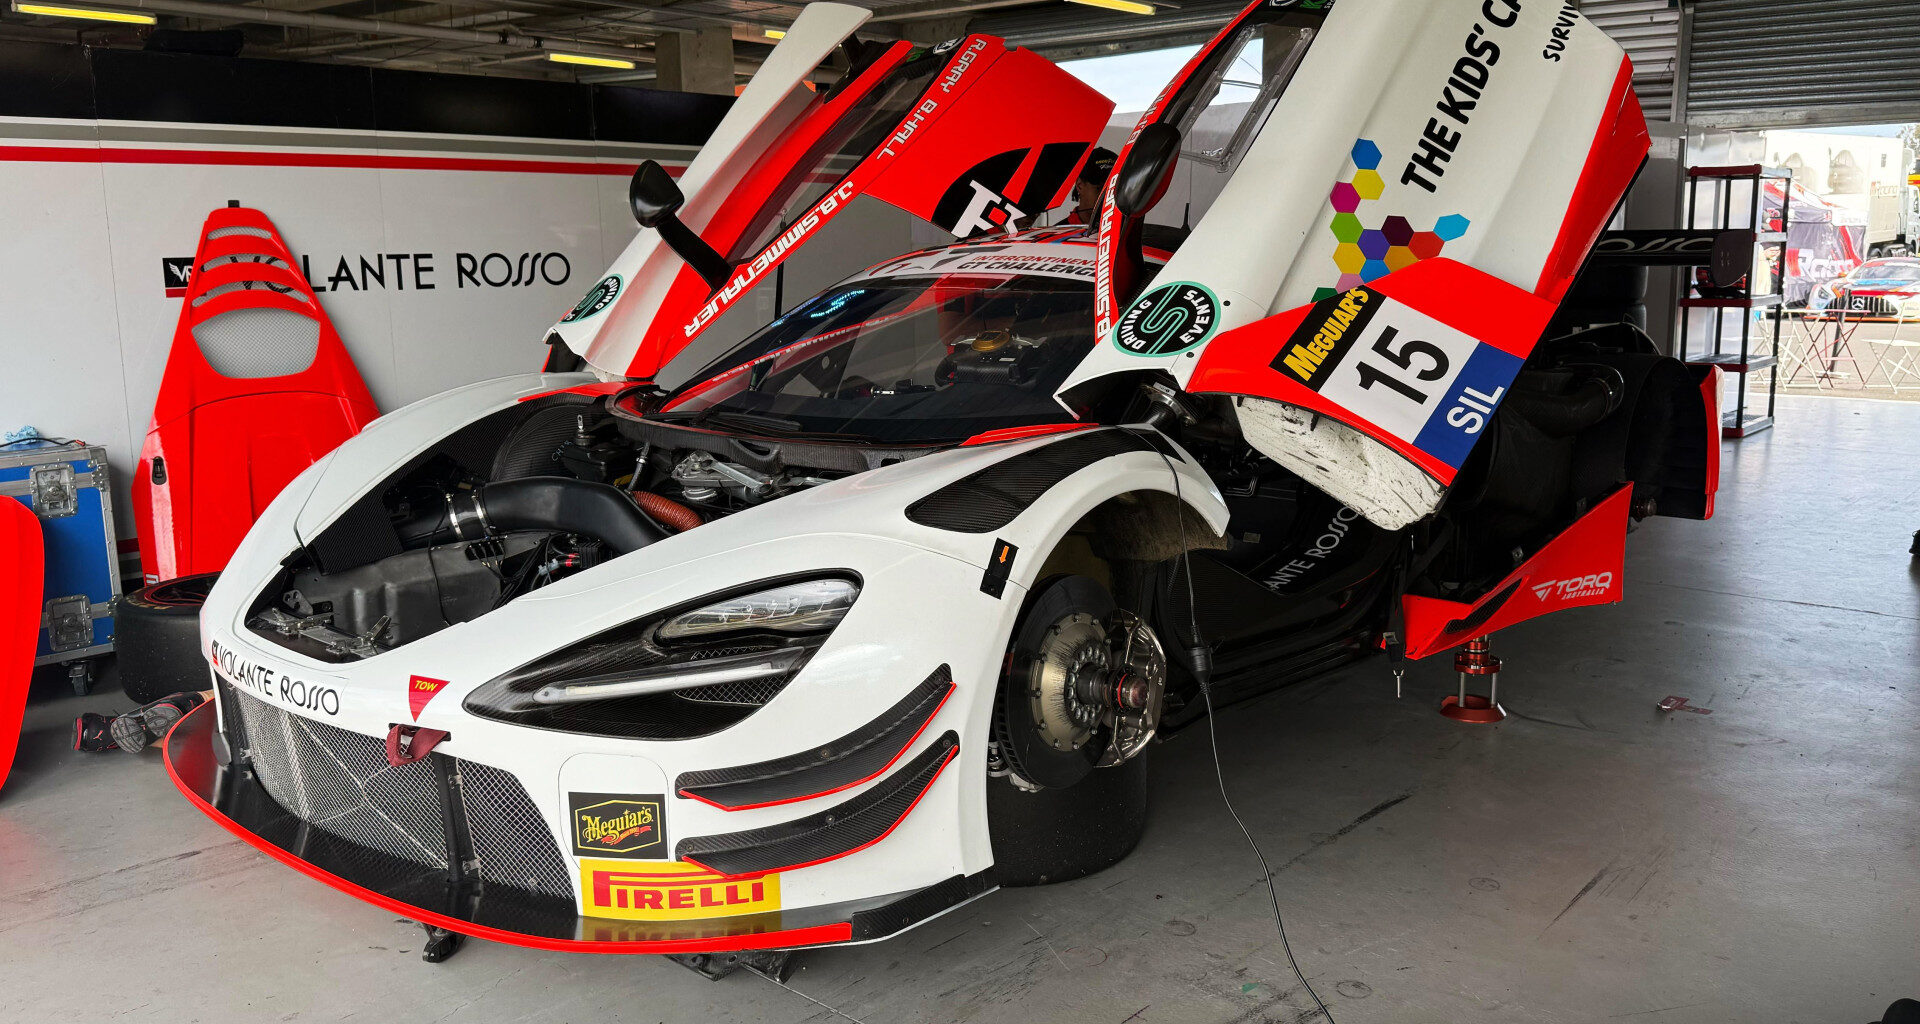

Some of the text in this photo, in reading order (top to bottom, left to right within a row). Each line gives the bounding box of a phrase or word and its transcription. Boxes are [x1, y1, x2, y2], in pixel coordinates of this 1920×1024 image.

[1400, 117, 1461, 193] THE
[1436, 23, 1500, 124] KIDS'
[456, 252, 571, 288] ROSSO
[1120, 299, 1152, 350] DRIVING
[1179, 289, 1211, 344] EVENTS
[1355, 325, 1449, 405] 15
[1446, 386, 1505, 434] SIL
[1303, 506, 1359, 559] ROSSO
[1556, 571, 1612, 595] TORQ
[218, 645, 273, 698] VOLANTE
[280, 675, 339, 716] ROSSO
[414, 680, 438, 692] TOW
[582, 806, 653, 845] Meguiar's
[592, 870, 764, 910] PIRELLI
